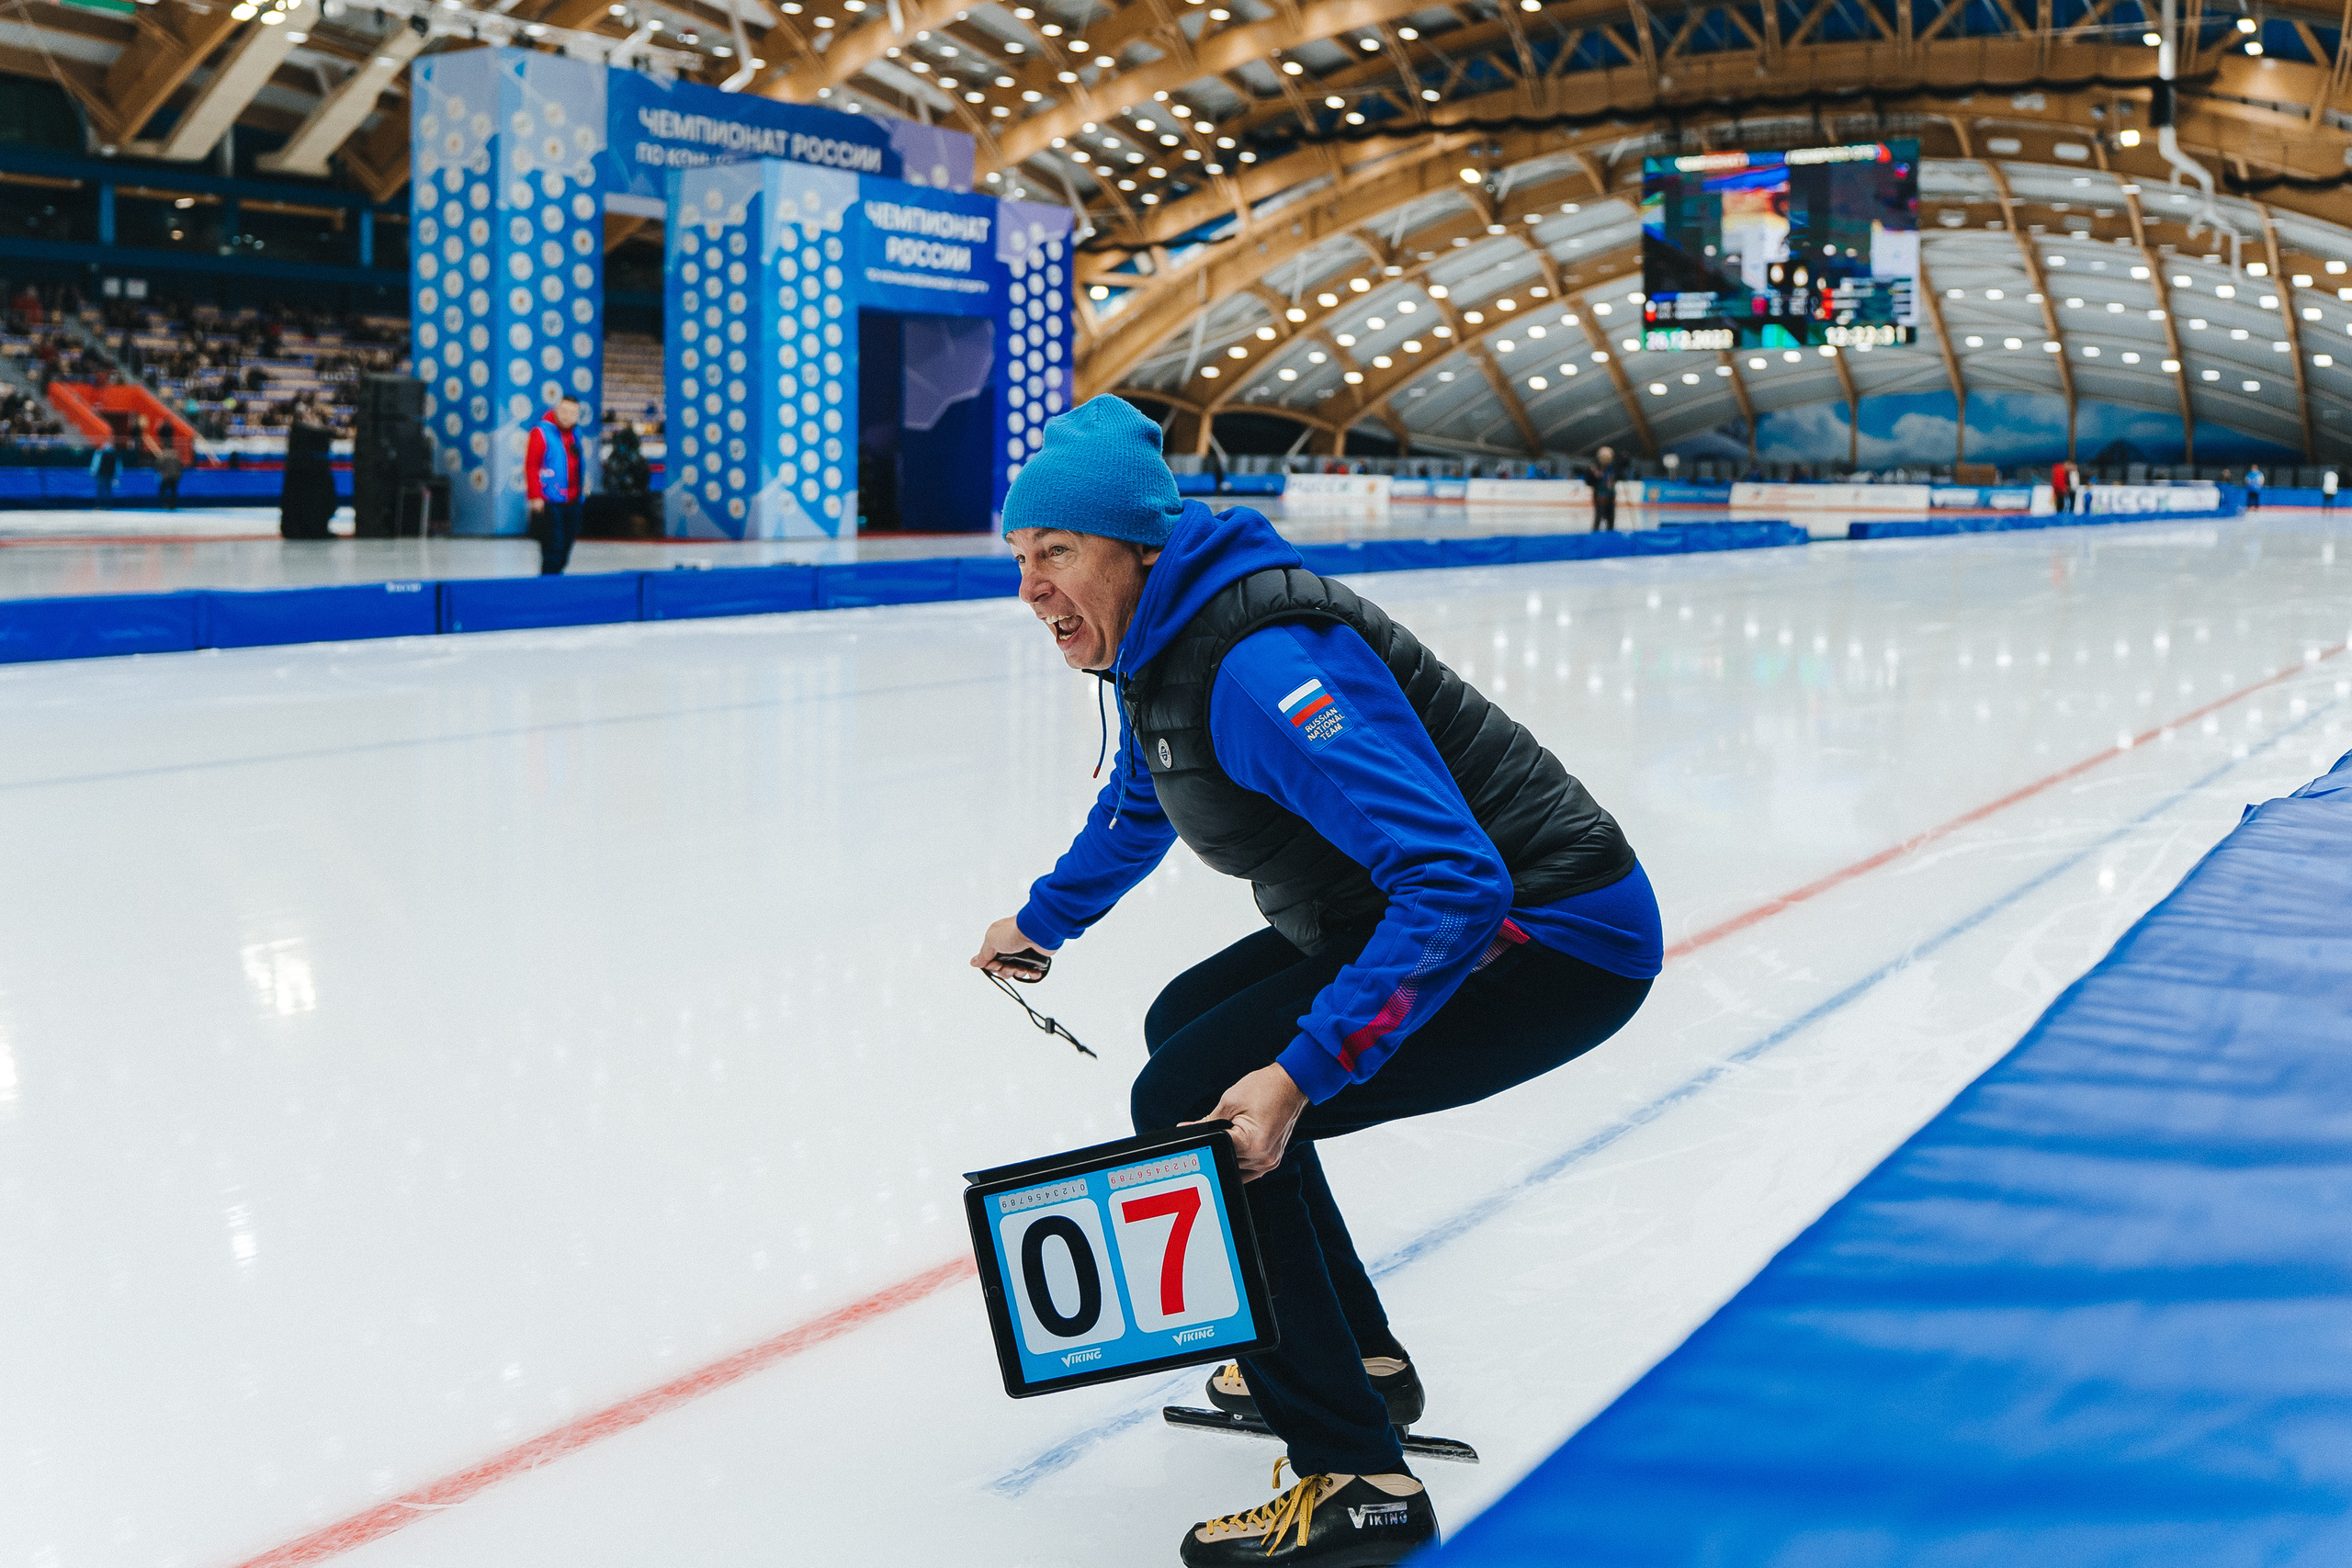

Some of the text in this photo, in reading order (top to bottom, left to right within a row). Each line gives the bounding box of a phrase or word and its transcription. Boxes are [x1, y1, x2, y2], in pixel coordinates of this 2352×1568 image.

[639, 107, 788, 157] ЧЕМПИОНАТ
[791, 132, 882, 173] РОССИИ
[865, 200, 991, 243] ЧЕМПИОНАТ
[886, 236, 971, 273] РОССИИ
[1305, 707, 1338, 733] RUSSIAN
[1307, 714, 1345, 741] NATIONAL
[1320, 723, 1343, 740] TEAM
[1172, 1325, 1216, 1347] VIKING
[1061, 1348, 1102, 1368] VIKING
[1348, 1501, 1408, 1529] VIKING
